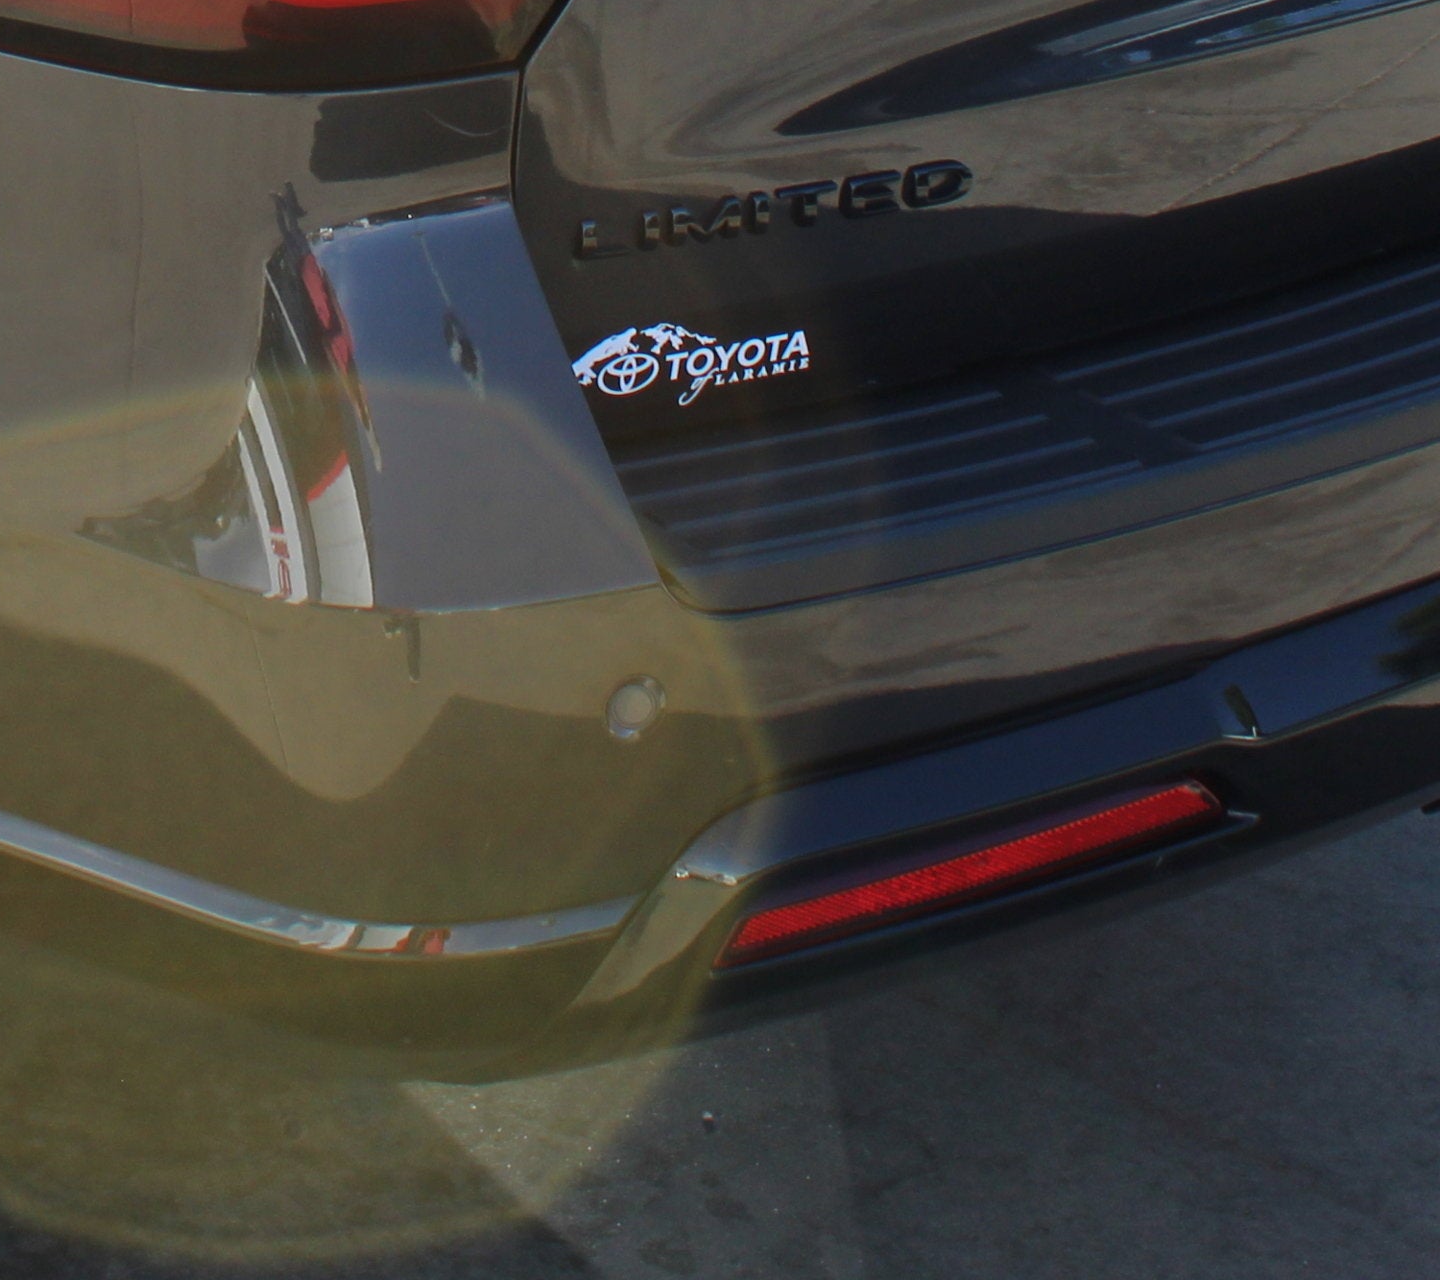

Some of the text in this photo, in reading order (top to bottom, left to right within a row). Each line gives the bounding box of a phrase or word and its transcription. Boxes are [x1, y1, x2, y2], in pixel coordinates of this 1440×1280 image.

[573, 158, 974, 262] LIMITED
[665, 329, 810, 381] TOYOTA
[714, 357, 810, 386] LARAMIE
